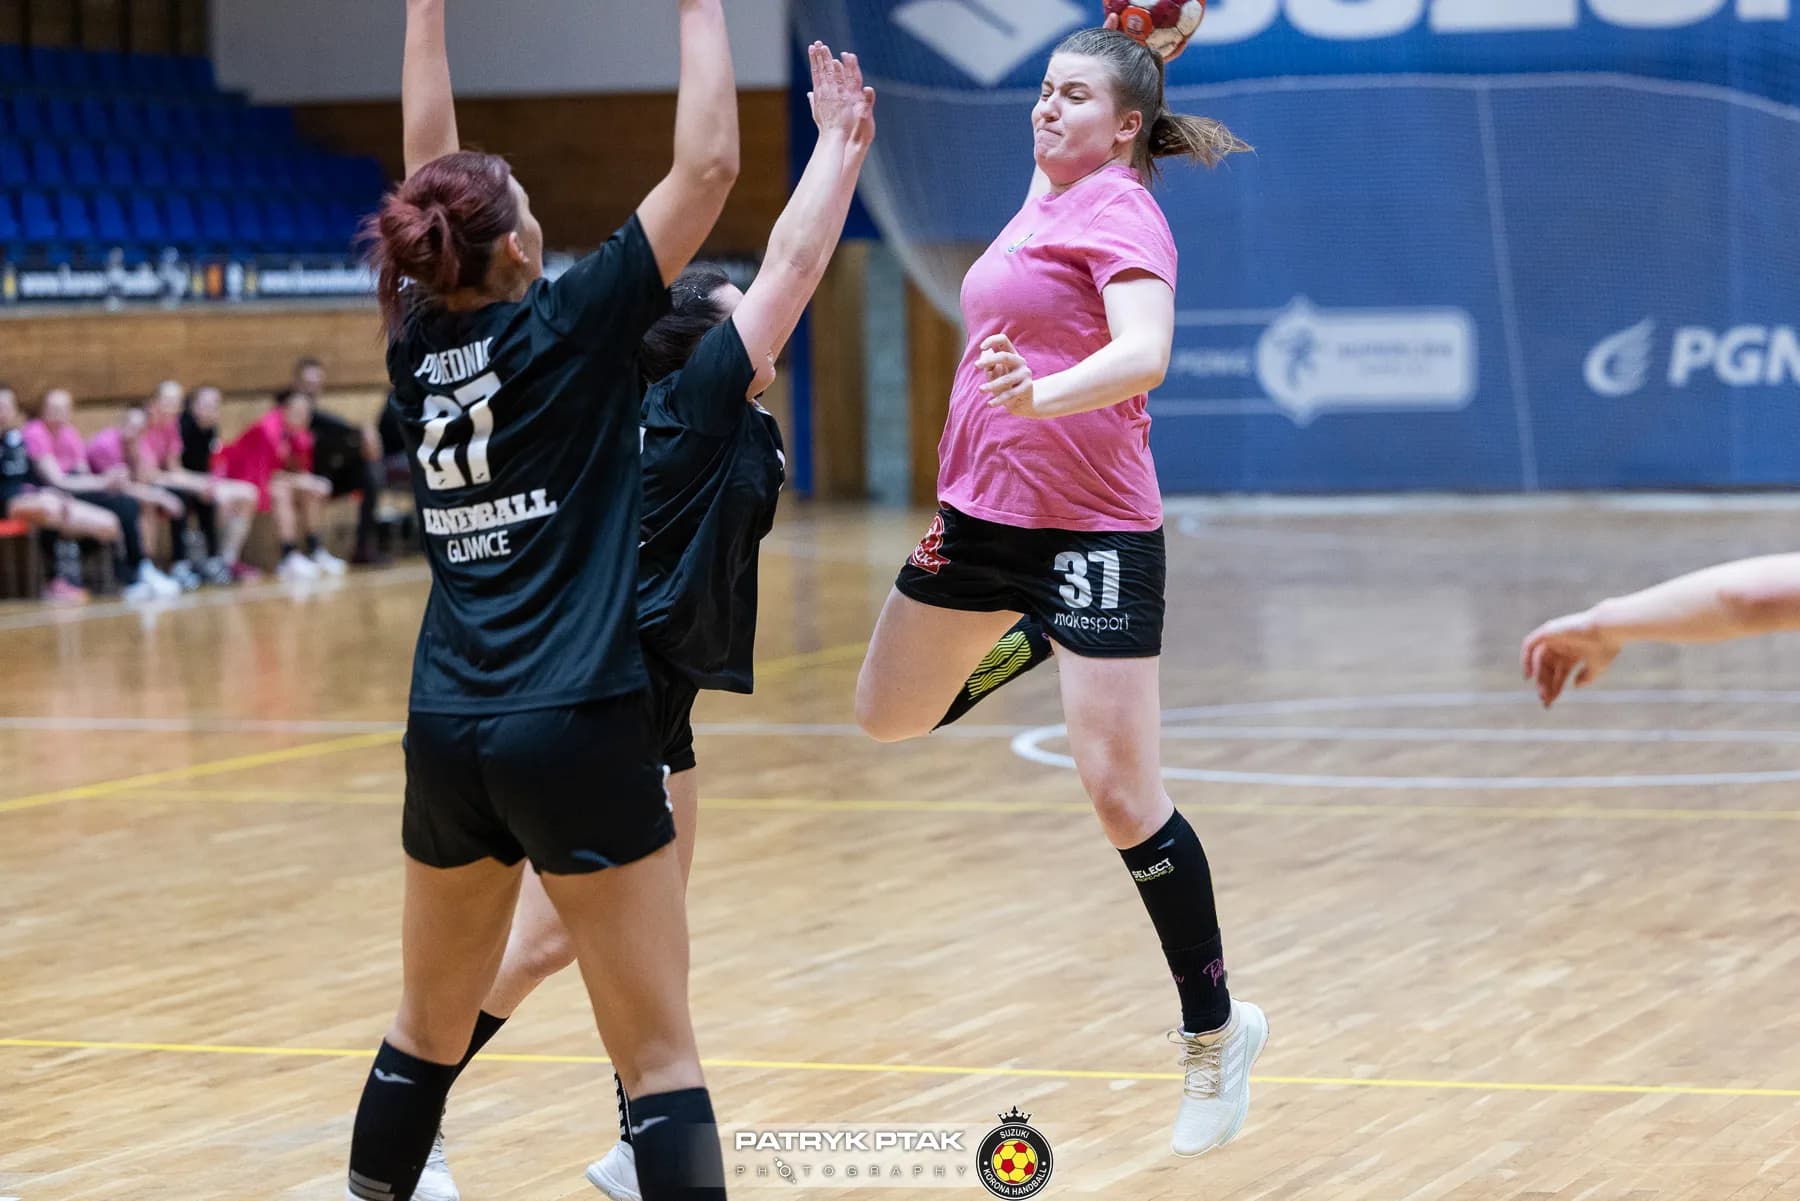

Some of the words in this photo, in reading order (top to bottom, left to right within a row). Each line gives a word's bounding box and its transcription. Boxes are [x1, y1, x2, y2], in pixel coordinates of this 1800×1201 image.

[417, 371, 501, 490] 27
[447, 529, 511, 563] GLIWICE
[1053, 549, 1120, 609] 37
[1054, 610, 1131, 634] makesport
